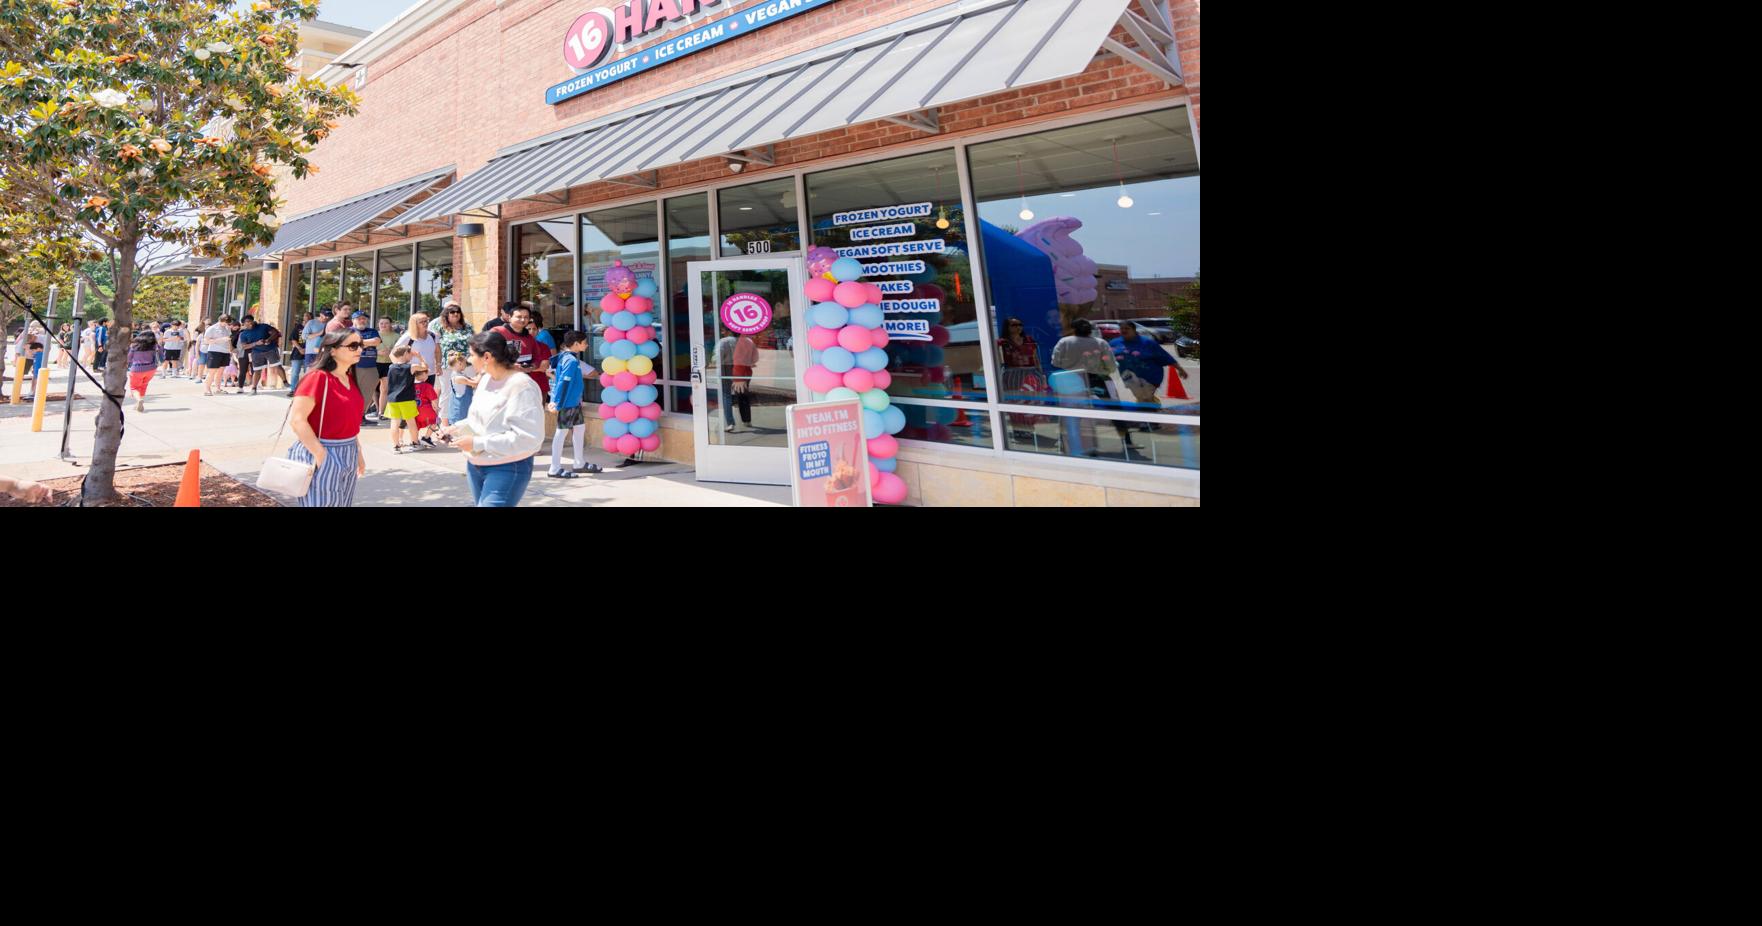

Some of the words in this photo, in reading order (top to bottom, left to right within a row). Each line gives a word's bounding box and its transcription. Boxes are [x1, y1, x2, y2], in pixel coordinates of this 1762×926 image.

[568, 20, 602, 62] 16
[556, 75, 593, 97] FROZEN
[595, 58, 638, 81] YOGURT
[655, 43, 675, 59] ICE
[676, 24, 724, 50] CREAM
[835, 211, 879, 223] FROZEN
[879, 204, 930, 218] YOGURT
[852, 229, 871, 239] ICE
[871, 224, 913, 237] CREAM
[749, 241, 769, 254] 500
[871, 244, 899, 255] SOFT
[902, 241, 942, 253] SERVE
[862, 262, 922, 274] MOOTHIES
[892, 301, 937, 311] DOUGH
[733, 304, 758, 322] 16
[886, 321, 926, 331] MORE!
[798, 426, 821, 438] INTO
[823, 422, 857, 435] FITNESS
[800, 442, 828, 453] FITNESS
[815, 459, 825, 467] MY
[803, 466, 829, 478] MOUTH
